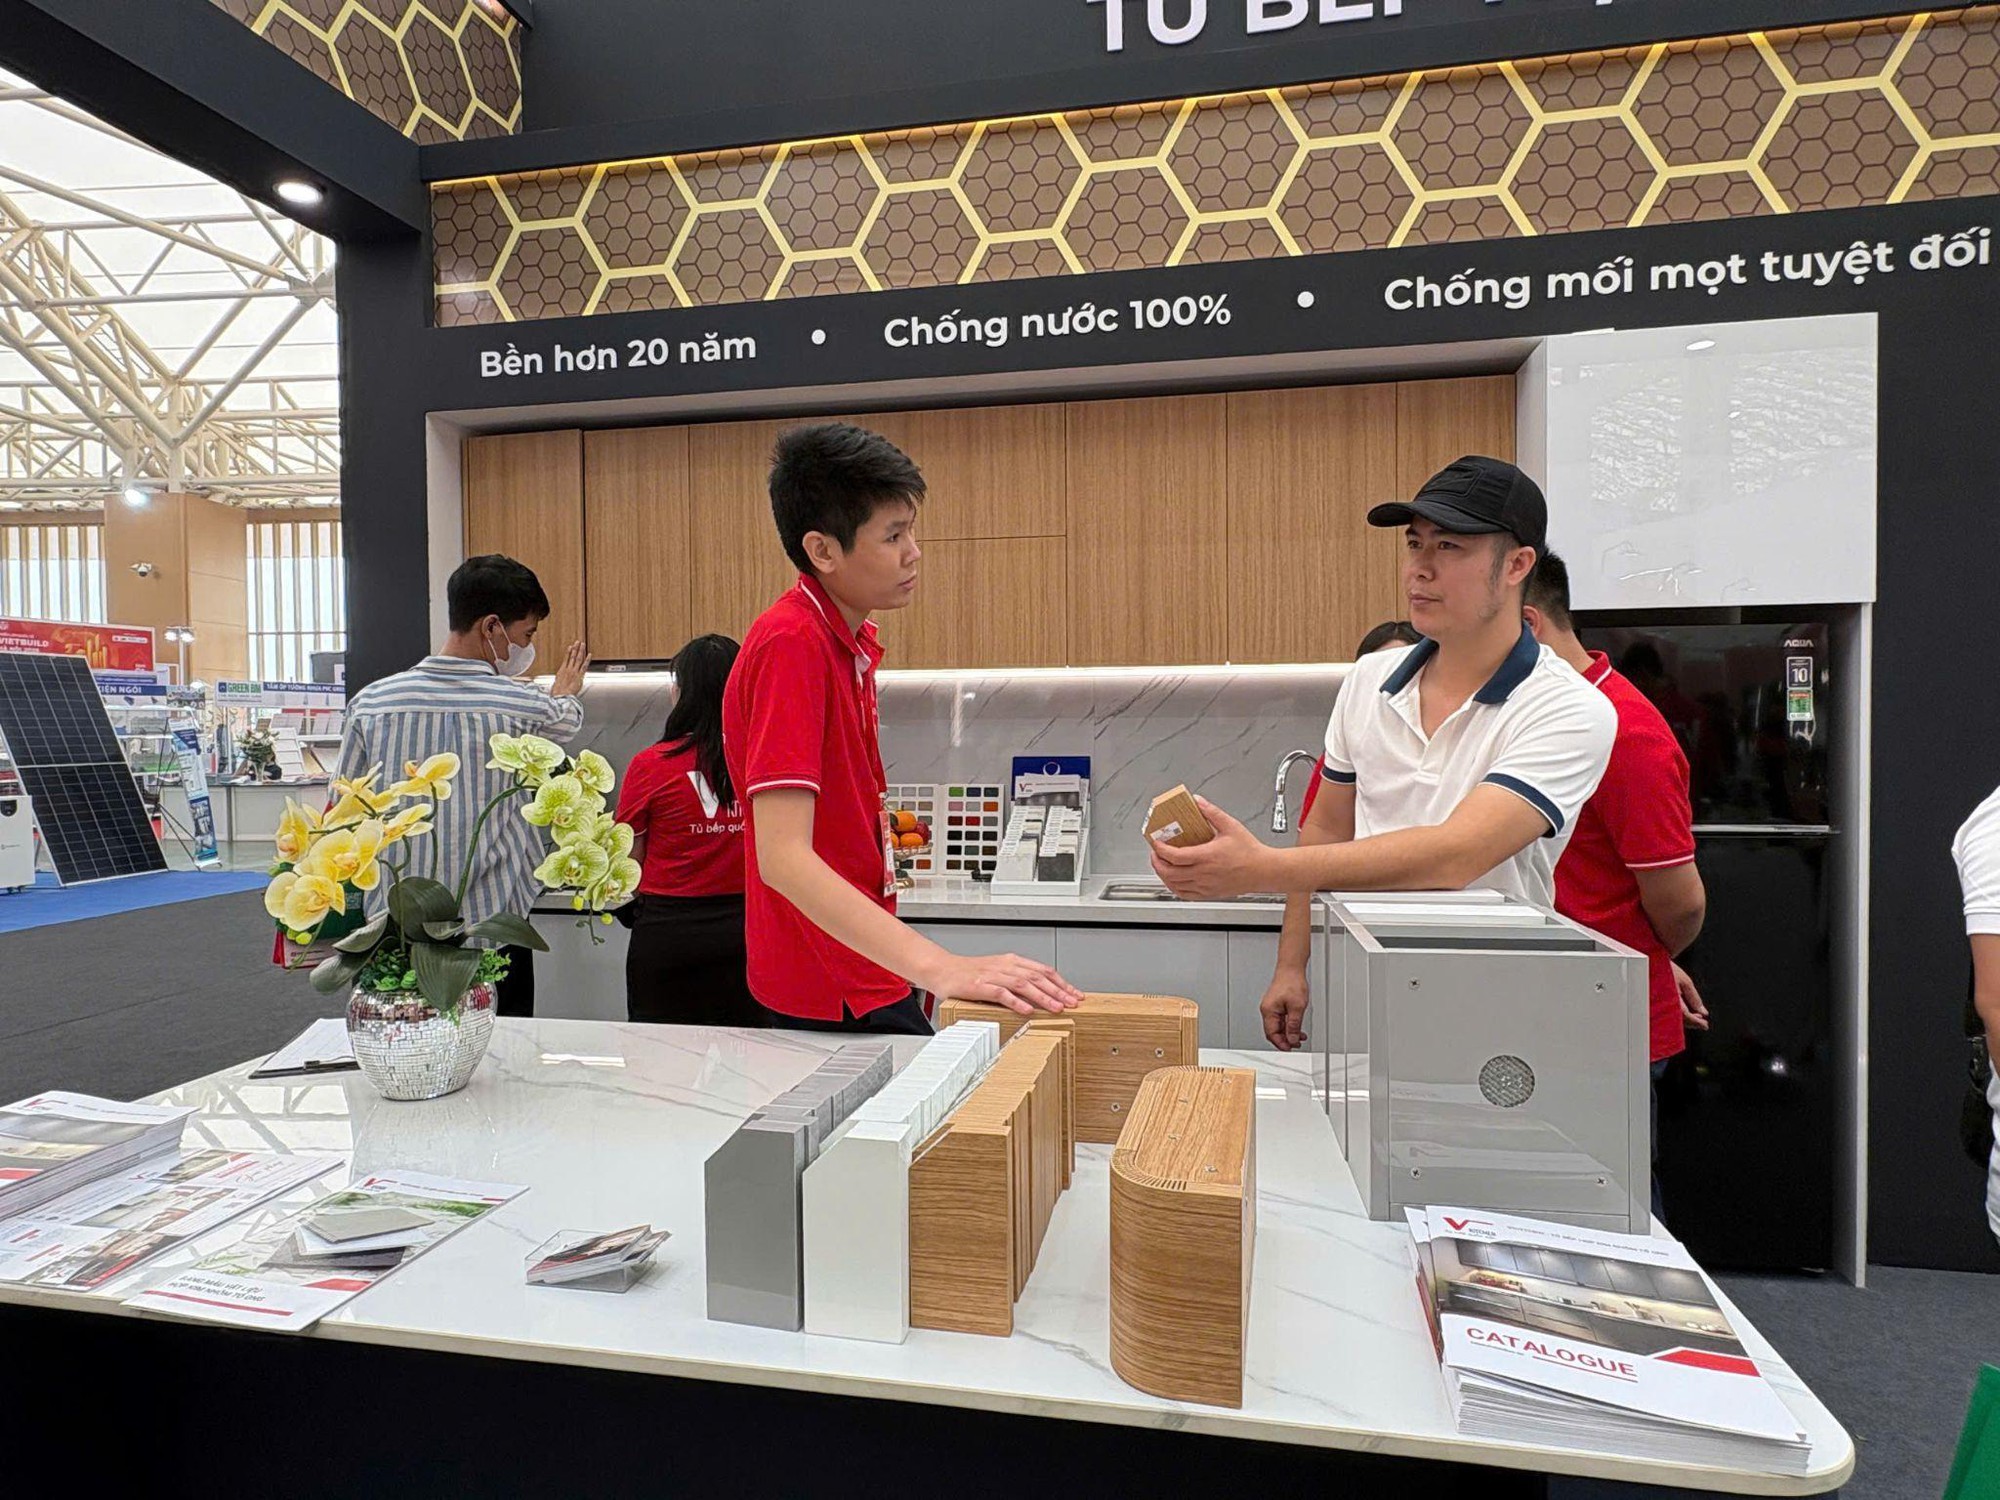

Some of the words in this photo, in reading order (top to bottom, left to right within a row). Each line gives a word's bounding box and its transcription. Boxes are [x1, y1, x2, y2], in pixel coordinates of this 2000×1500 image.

[1384, 267, 1531, 311] Chống
[1547, 255, 1634, 299] mối
[1650, 253, 1748, 296] mọt
[1760, 240, 1896, 287] tuyệt
[1909, 226, 1992, 271] đối
[884, 308, 1009, 348] Chống
[1021, 302, 1119, 338] nước
[1129, 293, 1232, 330] 100%
[480, 342, 544, 378] Bền
[554, 344, 618, 373] hơn
[627, 338, 669, 367] 20
[679, 332, 757, 364] năm
[1784, 639, 1814, 648] AQUA
[1792, 667, 1808, 683] 10
[689, 823, 703, 833] Tủ
[706, 821, 726, 834] bếp
[1466, 1327, 1638, 1378] CATALOGUE
